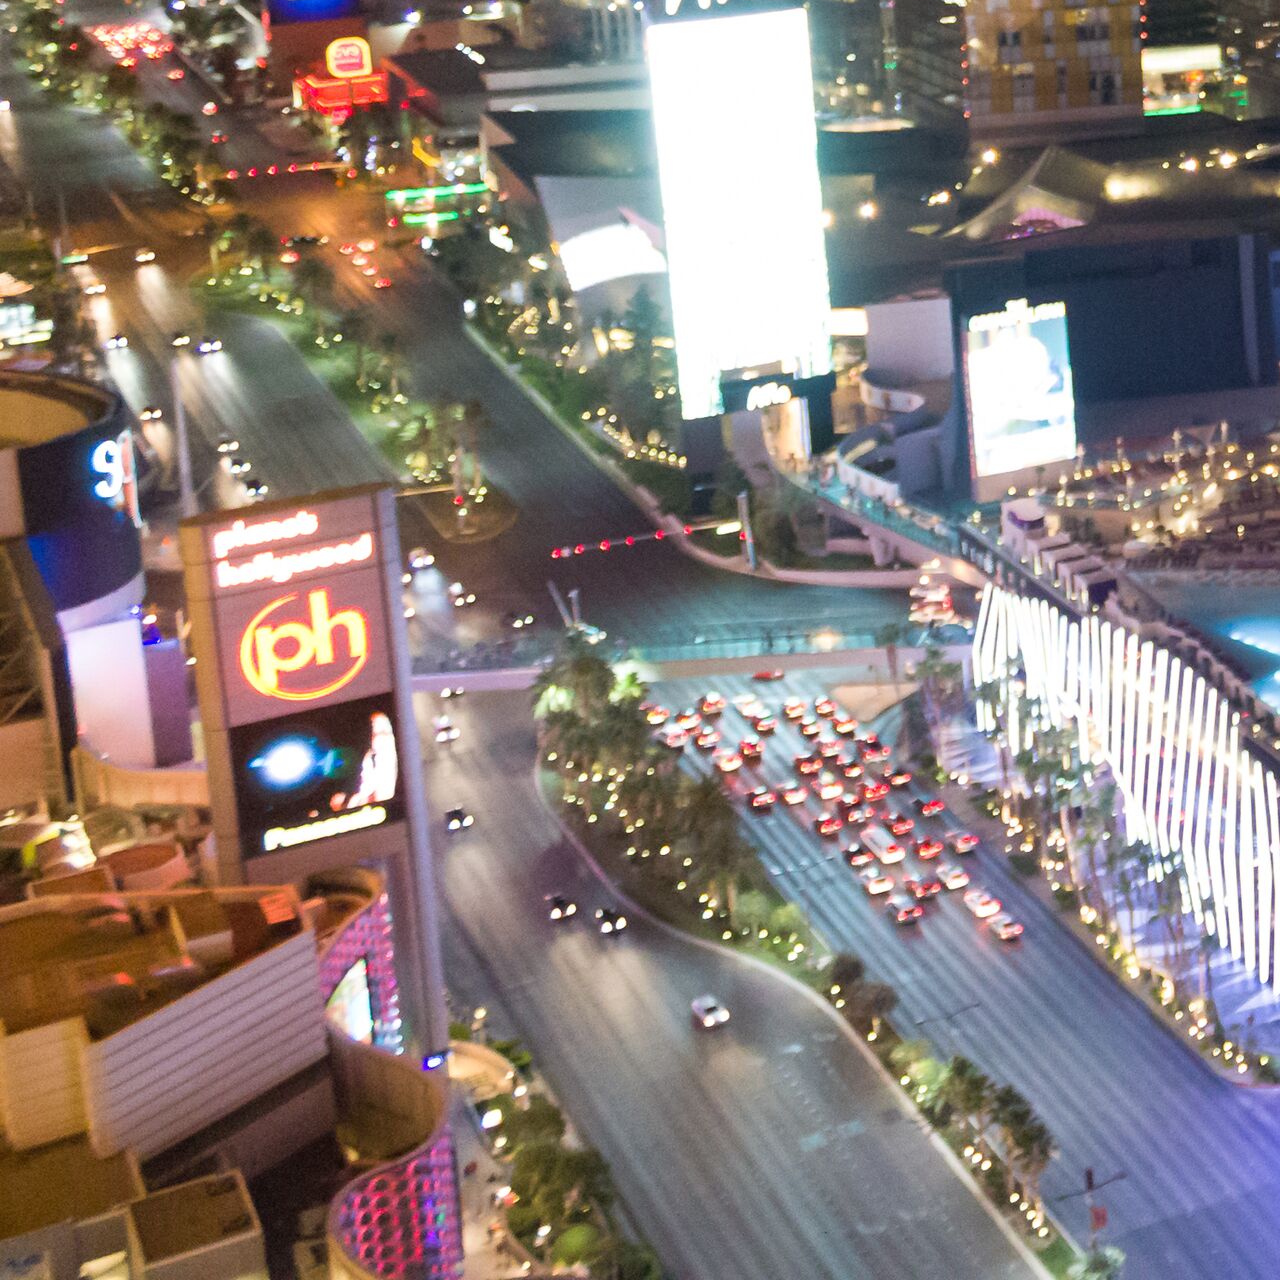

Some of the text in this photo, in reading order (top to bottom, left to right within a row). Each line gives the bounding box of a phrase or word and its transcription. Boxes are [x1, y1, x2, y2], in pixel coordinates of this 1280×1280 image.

[213, 510, 319, 559] planet
[216, 532, 374, 588] hollywood
[253, 587, 370, 690] ph
